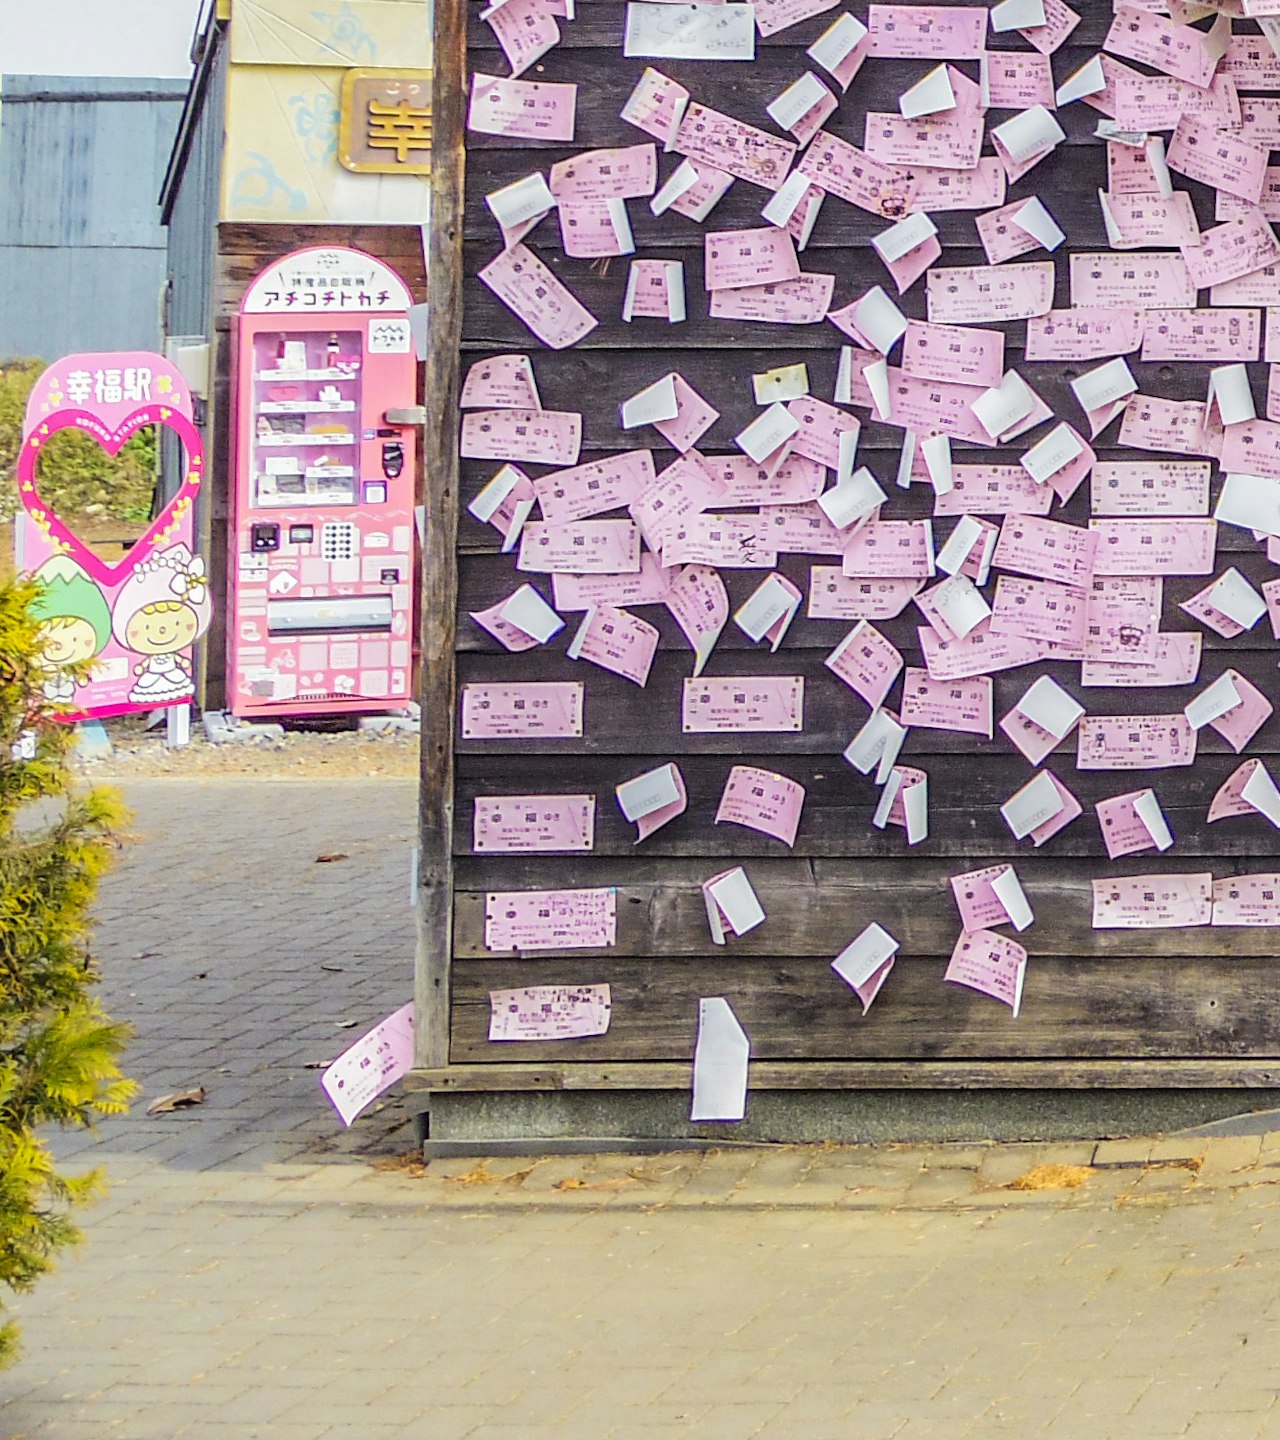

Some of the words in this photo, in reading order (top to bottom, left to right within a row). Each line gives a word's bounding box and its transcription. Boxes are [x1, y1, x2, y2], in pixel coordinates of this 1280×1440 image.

[264, 290, 390, 307] アチコチトカチ
[66, 367, 152, 405] 幸福駅
